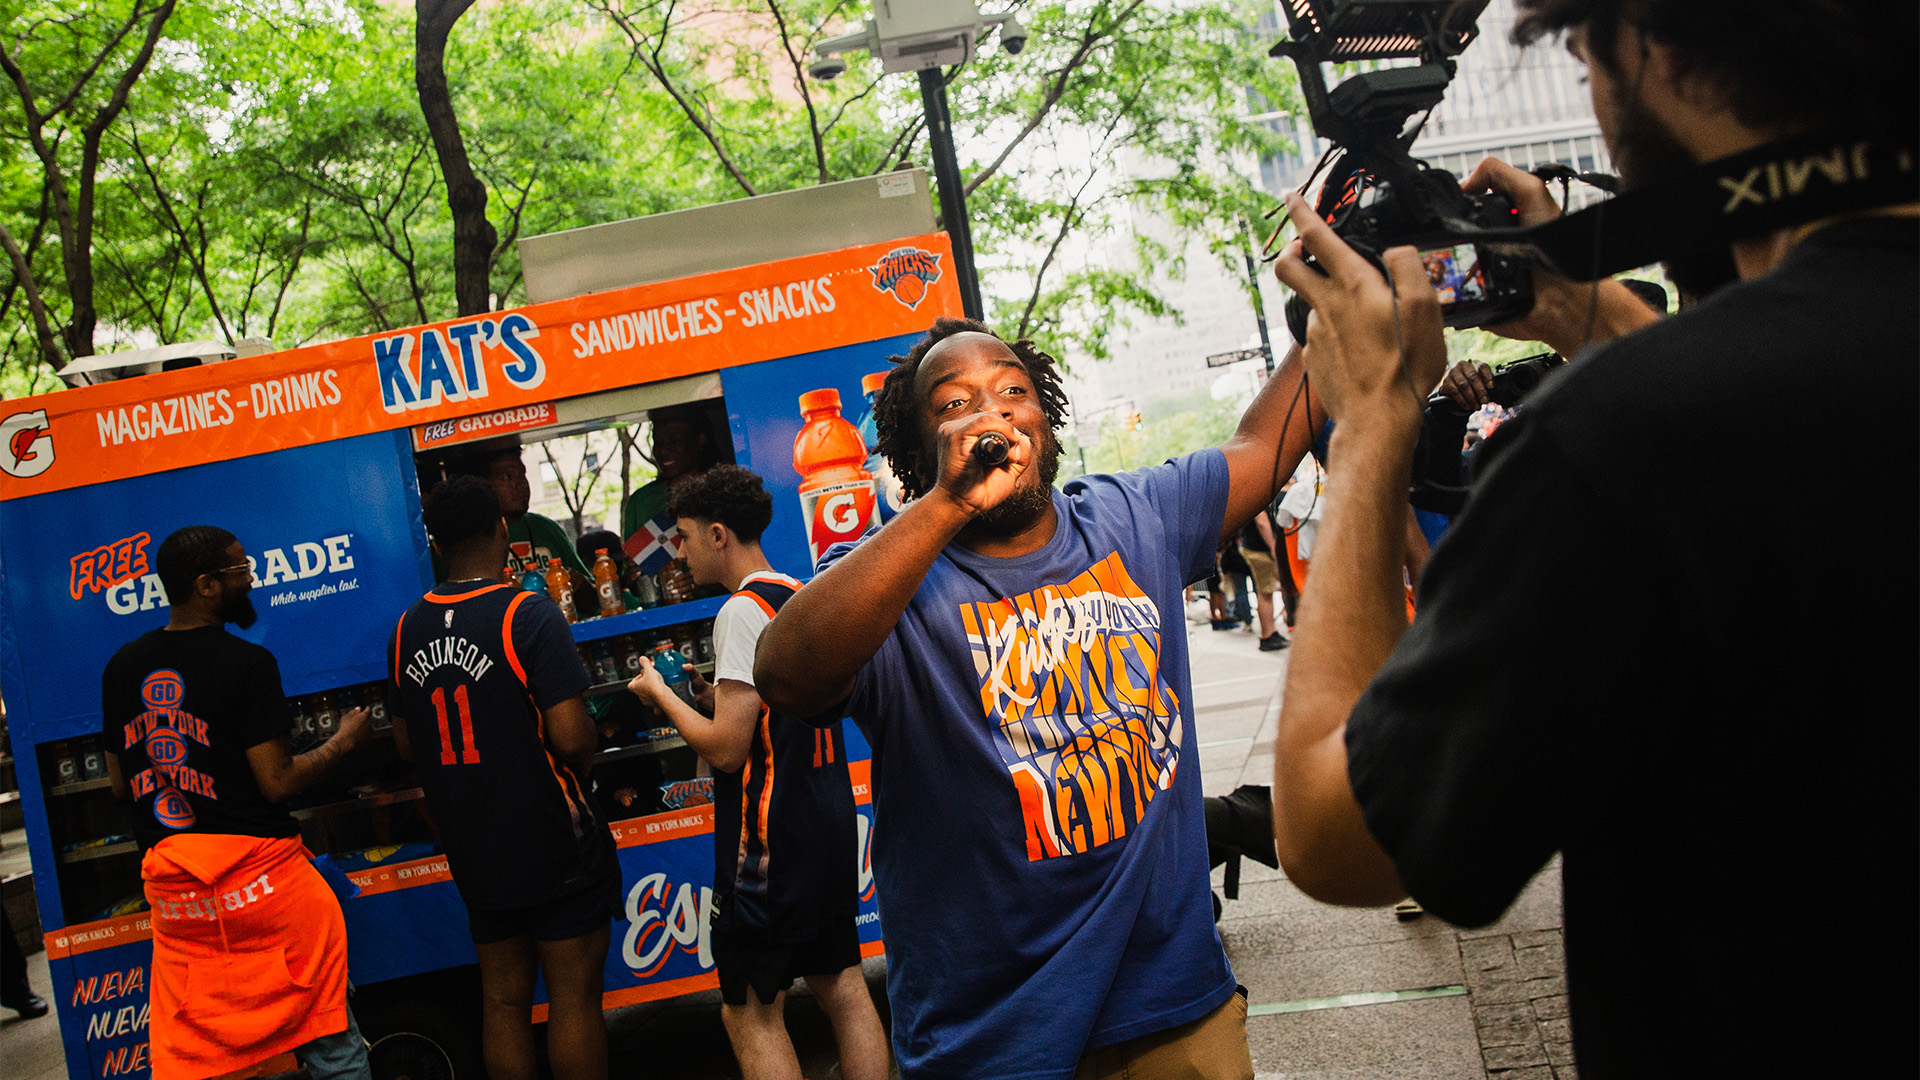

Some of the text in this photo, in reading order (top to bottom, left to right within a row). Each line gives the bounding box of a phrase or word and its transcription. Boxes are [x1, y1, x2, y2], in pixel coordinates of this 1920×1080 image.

[875, 252, 940, 286] KNICKS
[570, 297, 723, 359] SANDWICHES
[738, 277, 836, 328] SNACKS
[372, 313, 546, 415] KAT'S
[96, 388, 234, 447] MAGAZINES
[250, 368, 342, 419] DRINKS
[423, 404, 550, 443] FREE GATORADE
[822, 492, 860, 534] G
[70, 531, 151, 600] FREE
[270, 577, 359, 607] While supplies last.
[405, 636, 494, 688] BRUNSON
[151, 682, 176, 702] GO
[124, 707, 211, 750] NEW YORK
[431, 684, 481, 766] 11
[152, 741, 177, 760] GO
[168, 764, 218, 801] YORK
[645, 814, 704, 834] NEW YORK KNICKS
[397, 867, 412, 879] NEW
[413, 864, 431, 877] YORK
[55, 936, 70, 948] NEW
[71, 932, 90, 945] YORK
[89, 926, 115, 941] KNICKS
[72, 965, 144, 1007] NUEVA
